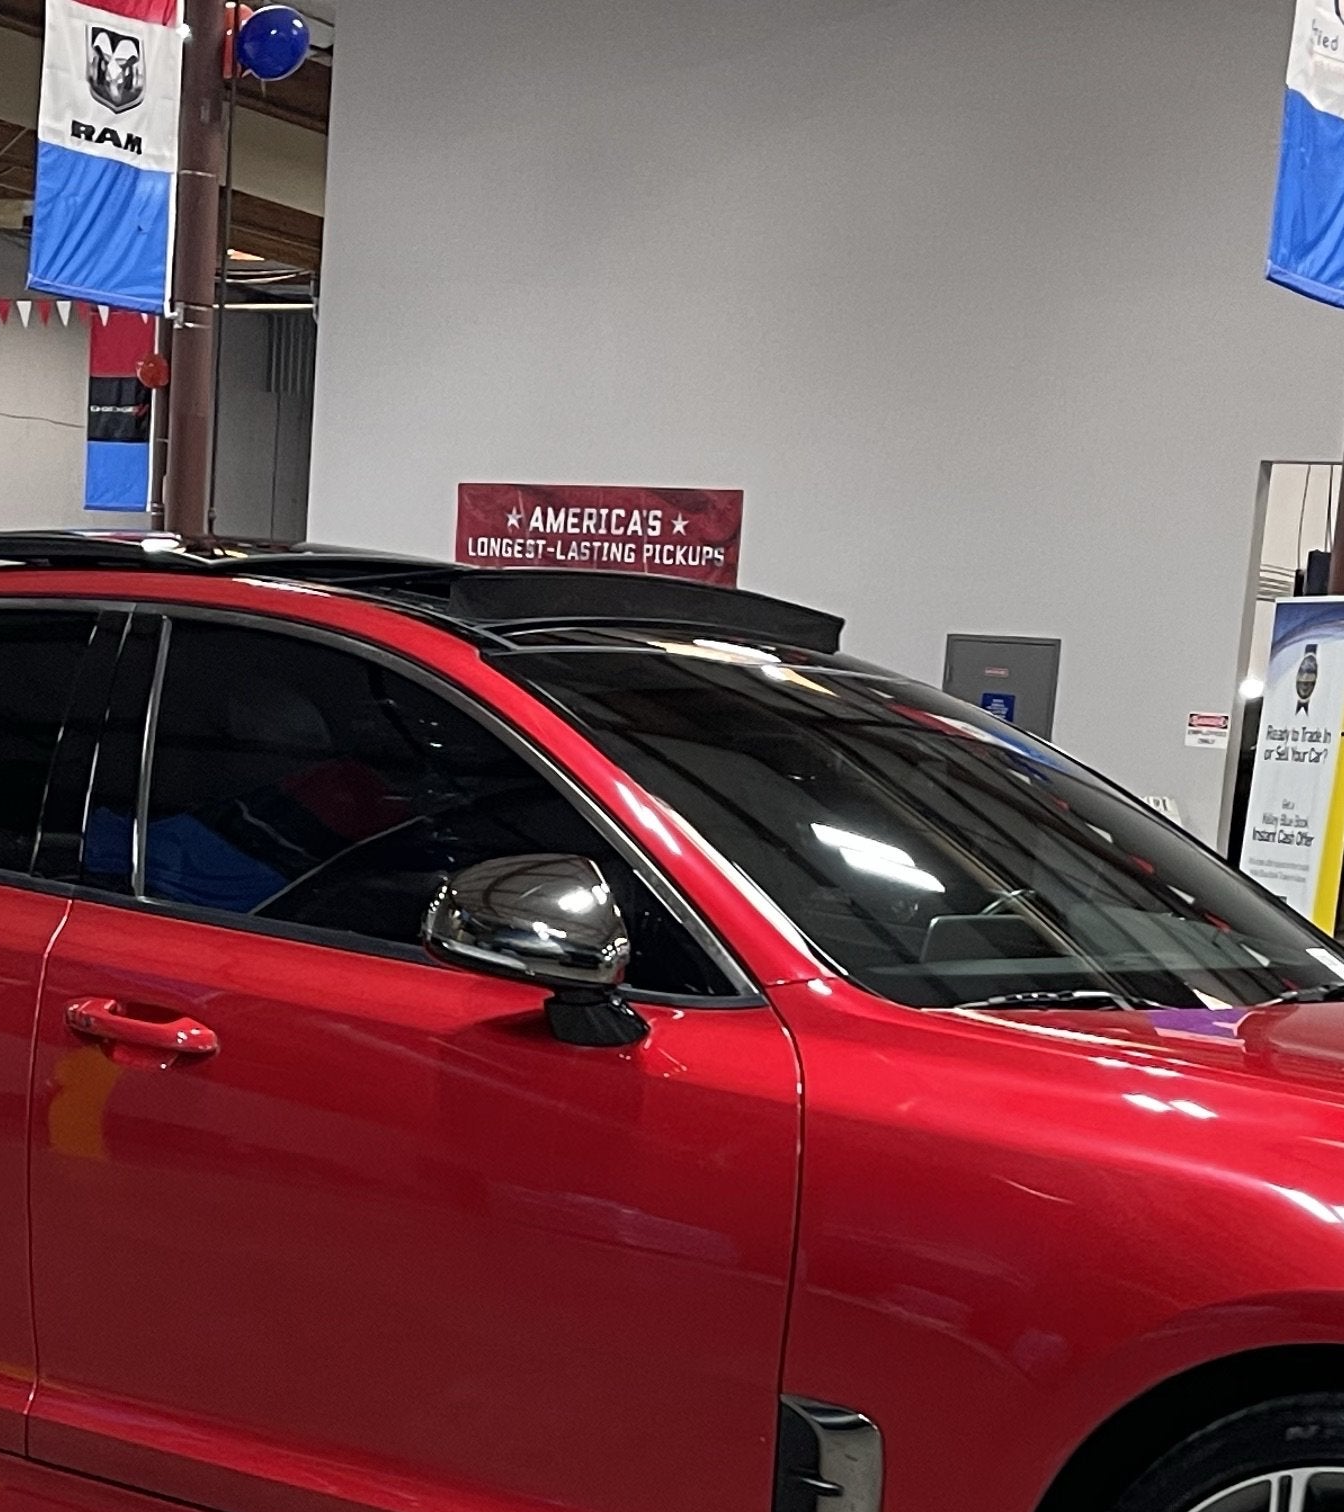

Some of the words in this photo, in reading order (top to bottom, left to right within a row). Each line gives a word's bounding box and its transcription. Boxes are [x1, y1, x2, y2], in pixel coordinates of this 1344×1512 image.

[70, 119, 143, 156] RAM
[528, 505, 663, 537] AMERICA'S
[467, 536, 636, 564] LONGEST-LASTING
[642, 543, 726, 568] PICKUPS
